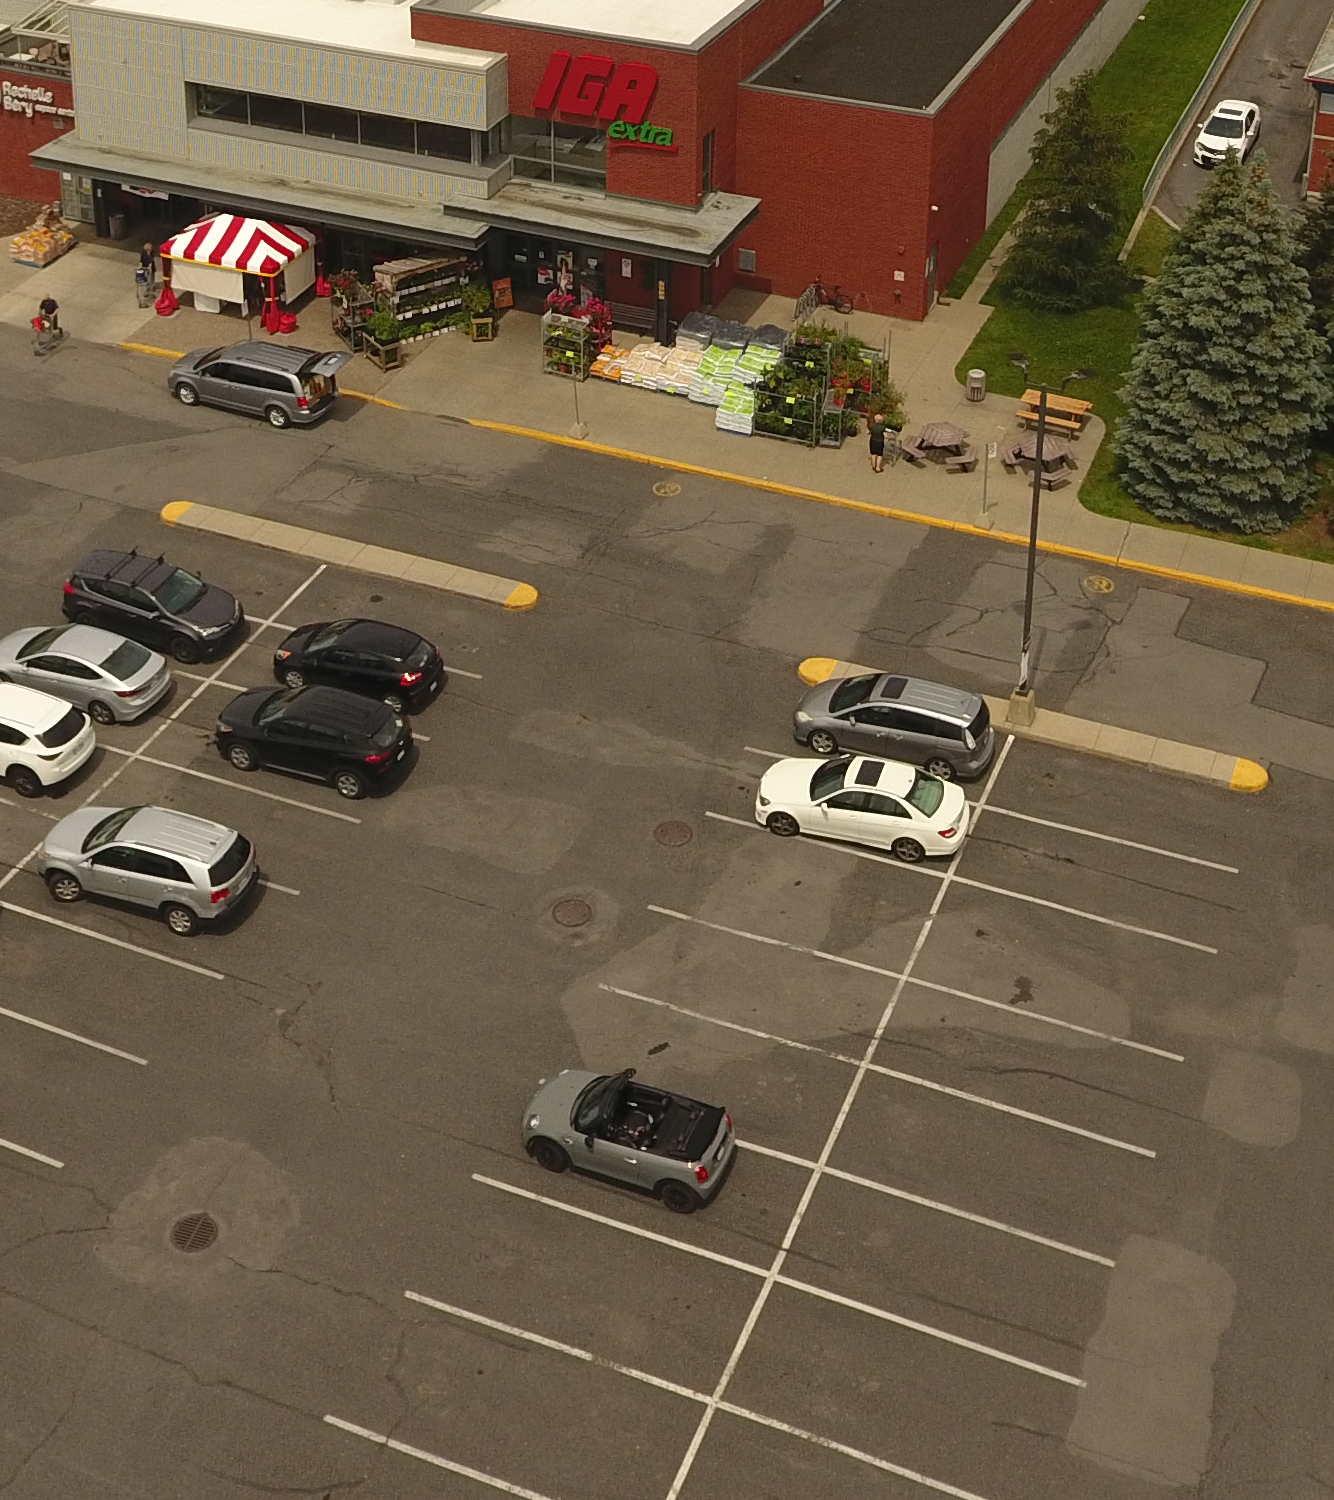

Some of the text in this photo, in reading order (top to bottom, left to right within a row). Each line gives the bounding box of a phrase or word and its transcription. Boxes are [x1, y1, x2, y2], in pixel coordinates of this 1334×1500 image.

[2, 81, 53, 103] Rachelle
[533, 50, 658, 124] IGA
[608, 120, 673, 146] extra
